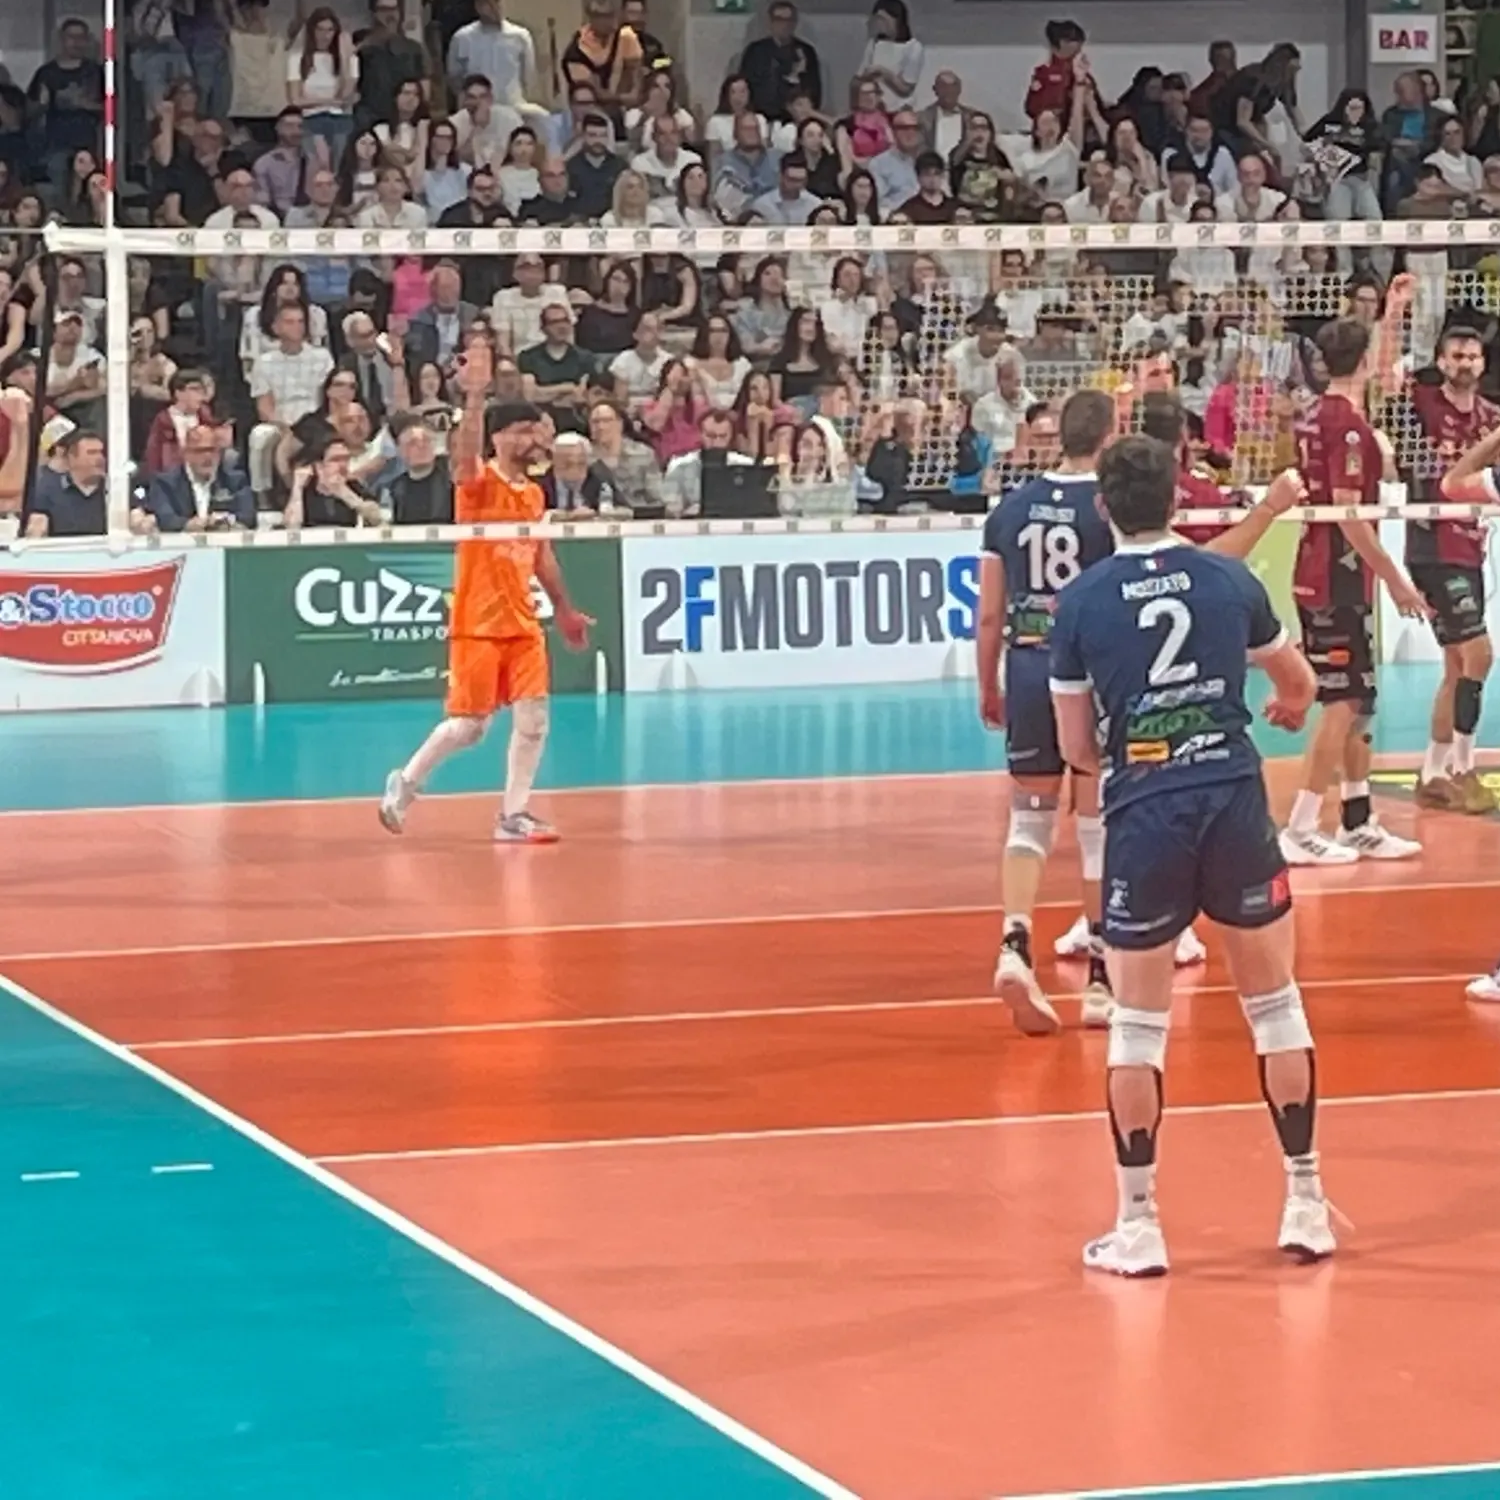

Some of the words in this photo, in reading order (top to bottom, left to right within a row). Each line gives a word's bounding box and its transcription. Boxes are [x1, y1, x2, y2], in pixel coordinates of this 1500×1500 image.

[1378, 29, 1430, 51] BAR
[1017, 522, 1082, 591] 18
[370, 626, 450, 642] TRASPO
[1137, 596, 1199, 687] 2
